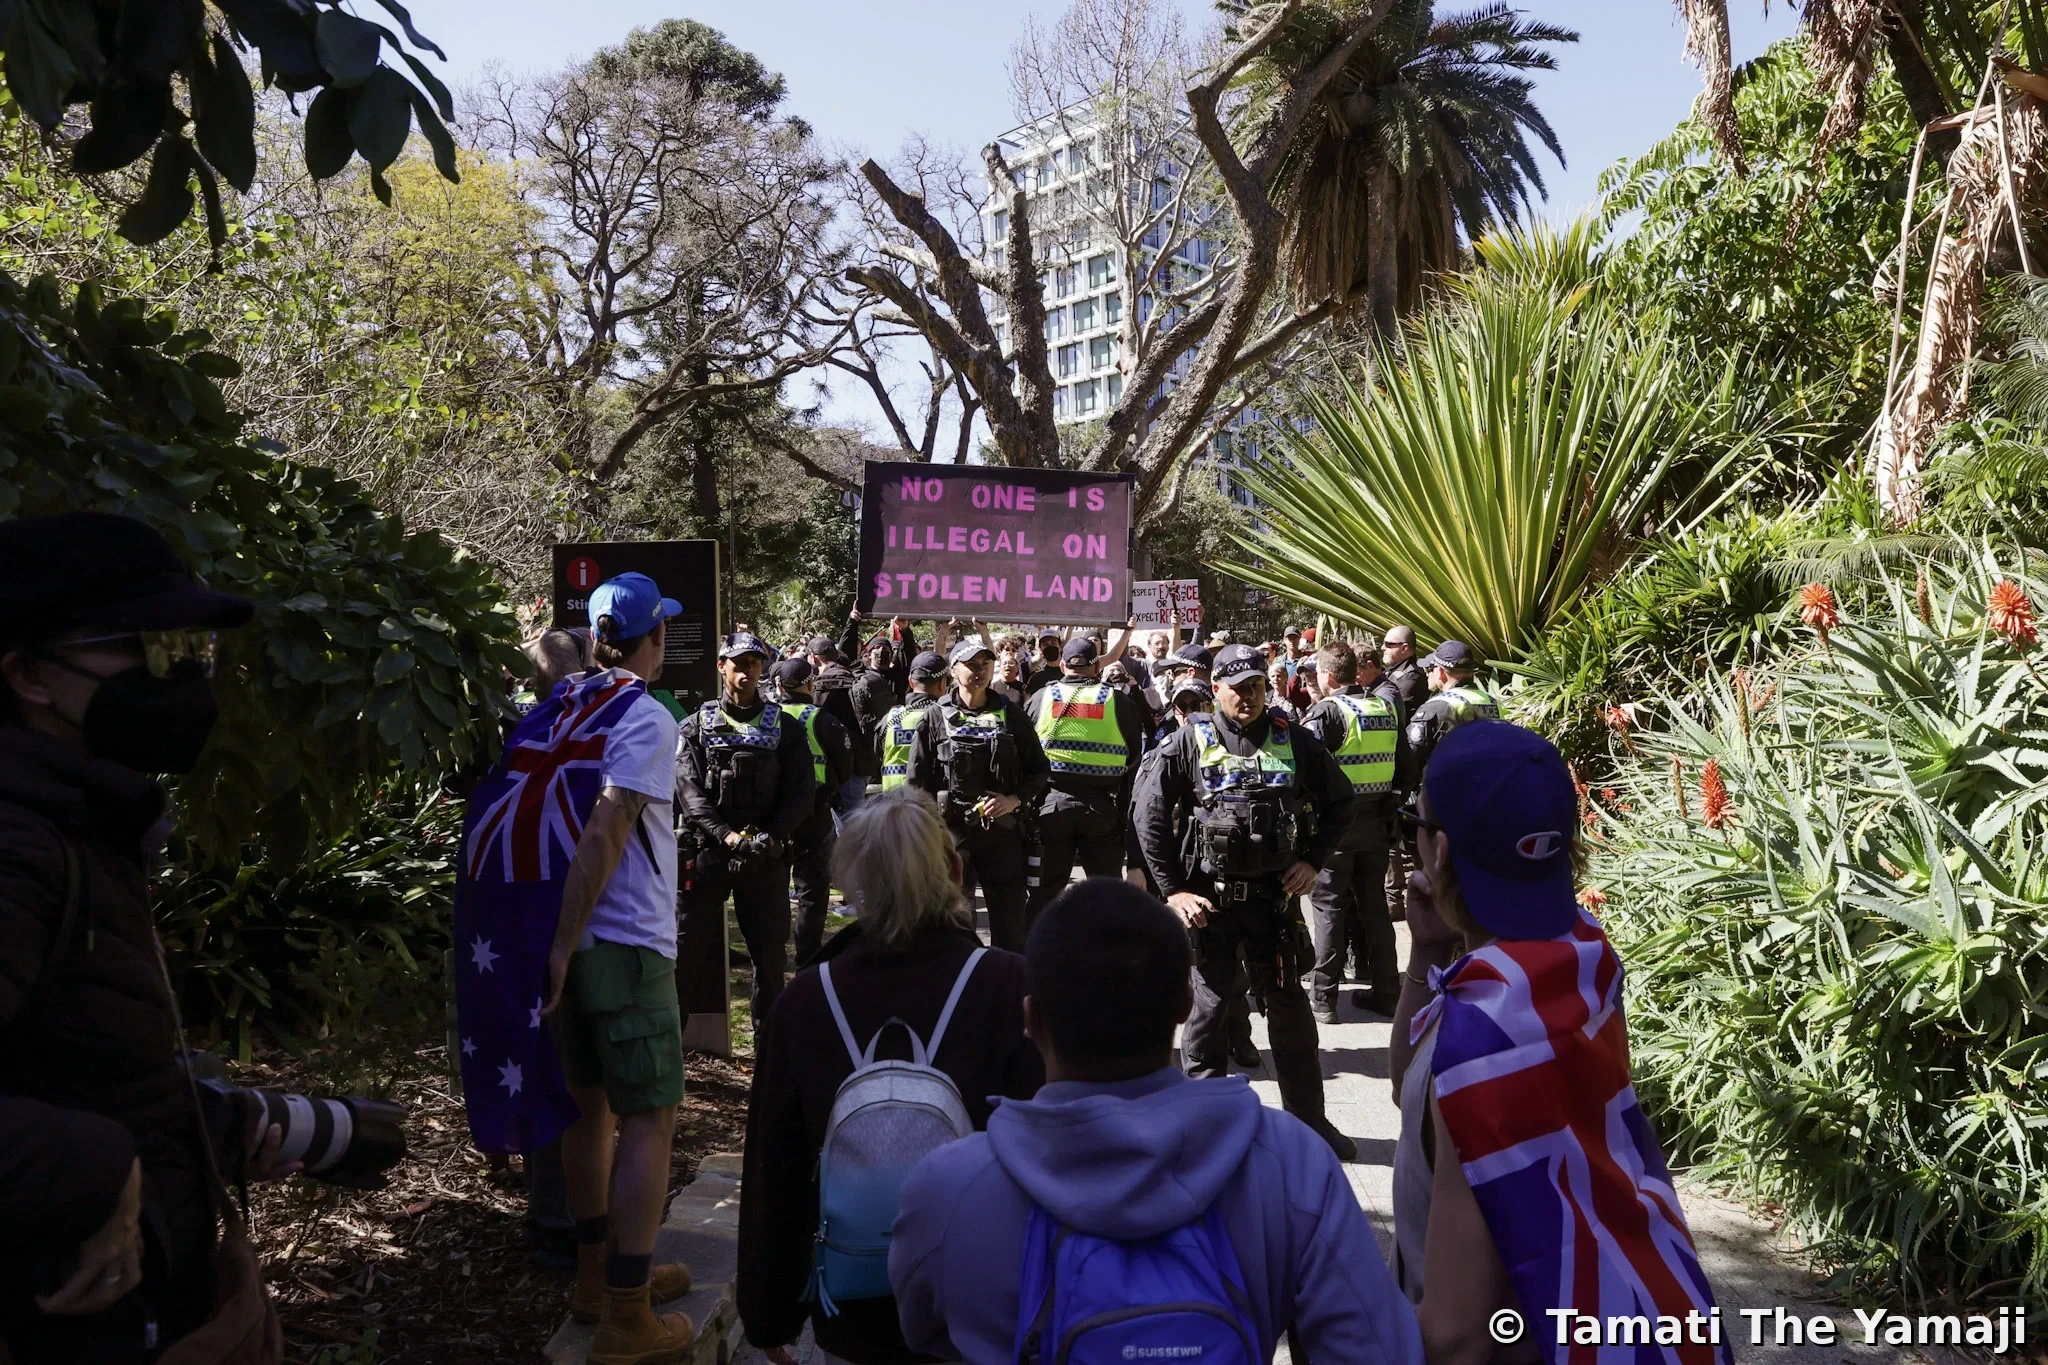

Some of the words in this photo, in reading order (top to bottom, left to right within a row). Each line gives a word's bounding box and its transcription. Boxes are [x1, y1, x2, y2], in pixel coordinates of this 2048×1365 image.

[901, 476, 943, 502] NO
[972, 484, 1036, 511] ONE
[1068, 487, 1105, 511] IS
[888, 525, 1035, 555] ILLEGAL
[1063, 534, 1107, 559] ON
[873, 572, 1007, 603] STOLEN
[1025, 574, 1113, 602] LAND
[1156, 599, 1167, 608] OR
[1133, 612, 1159, 623] XPECT
[1360, 716, 1396, 729] POLICE
[1137, 1345, 1203, 1357] SUISSEWIN
